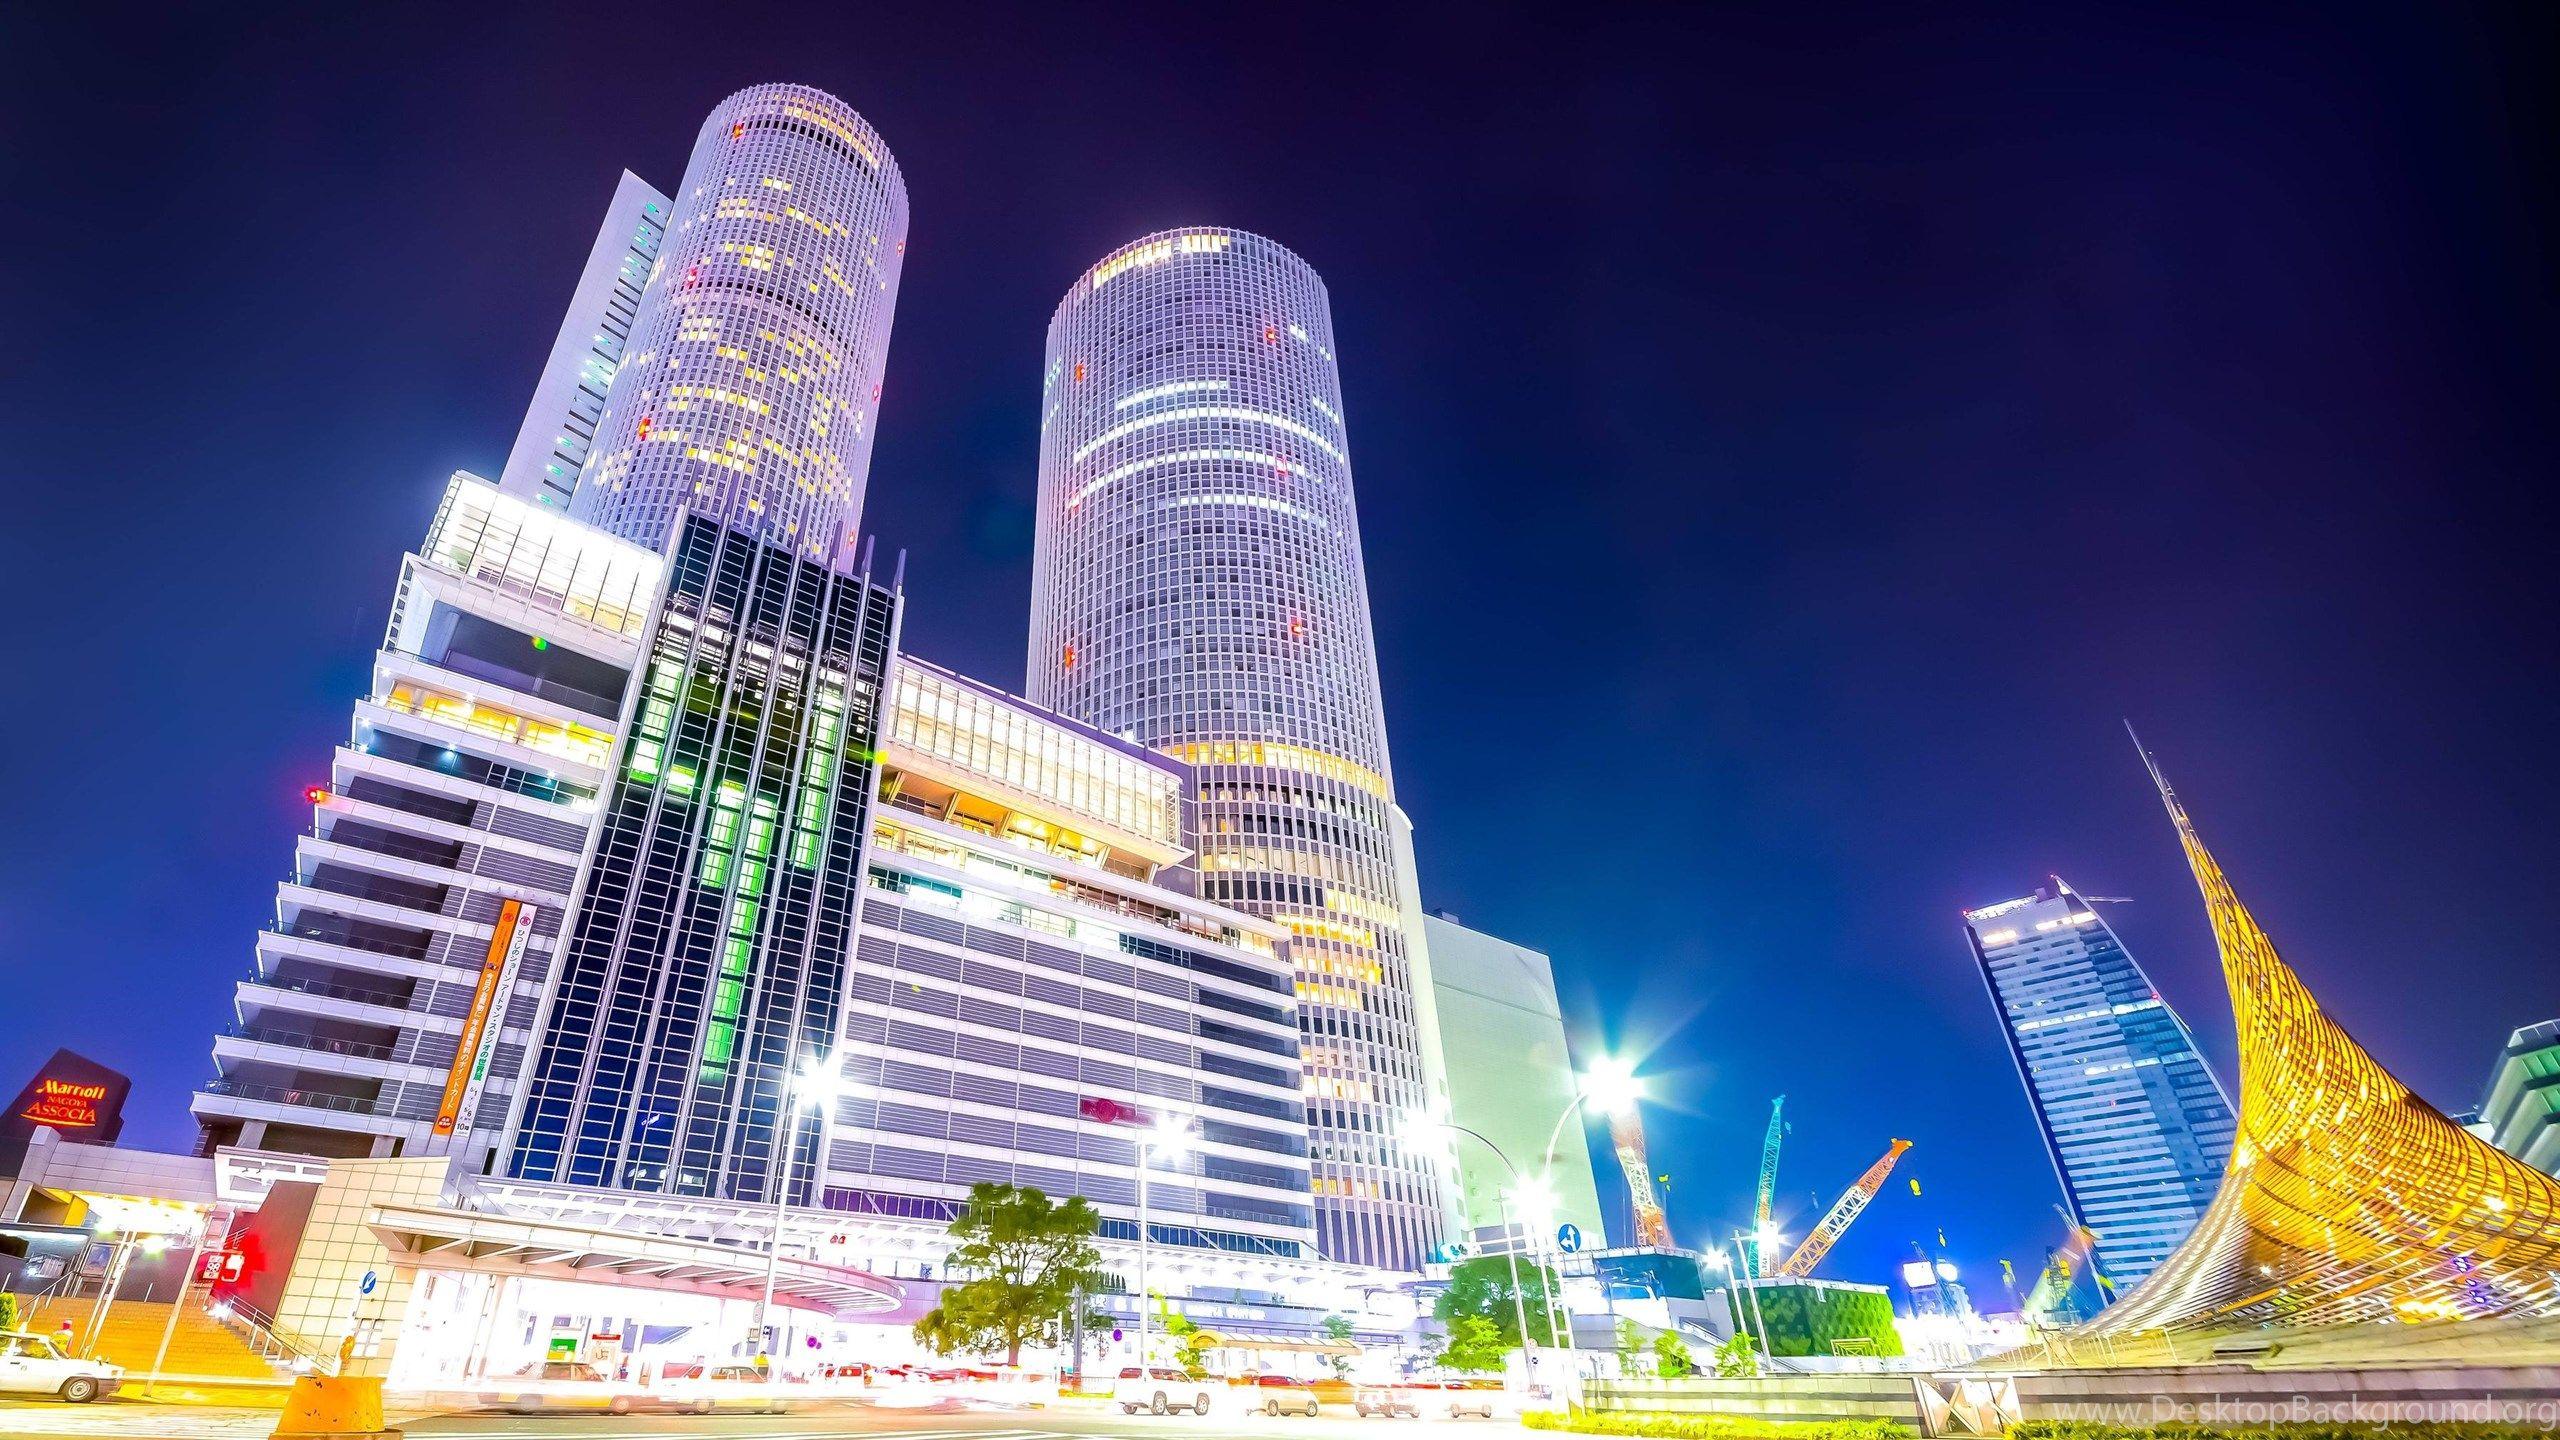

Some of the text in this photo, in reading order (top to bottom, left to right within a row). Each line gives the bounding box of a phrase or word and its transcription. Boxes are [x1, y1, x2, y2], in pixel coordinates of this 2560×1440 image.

[36, 1079, 106, 1100] Marriott
[27, 1101, 96, 1122] ASSOCIA
[47, 1096, 88, 1108] NAGOYA
